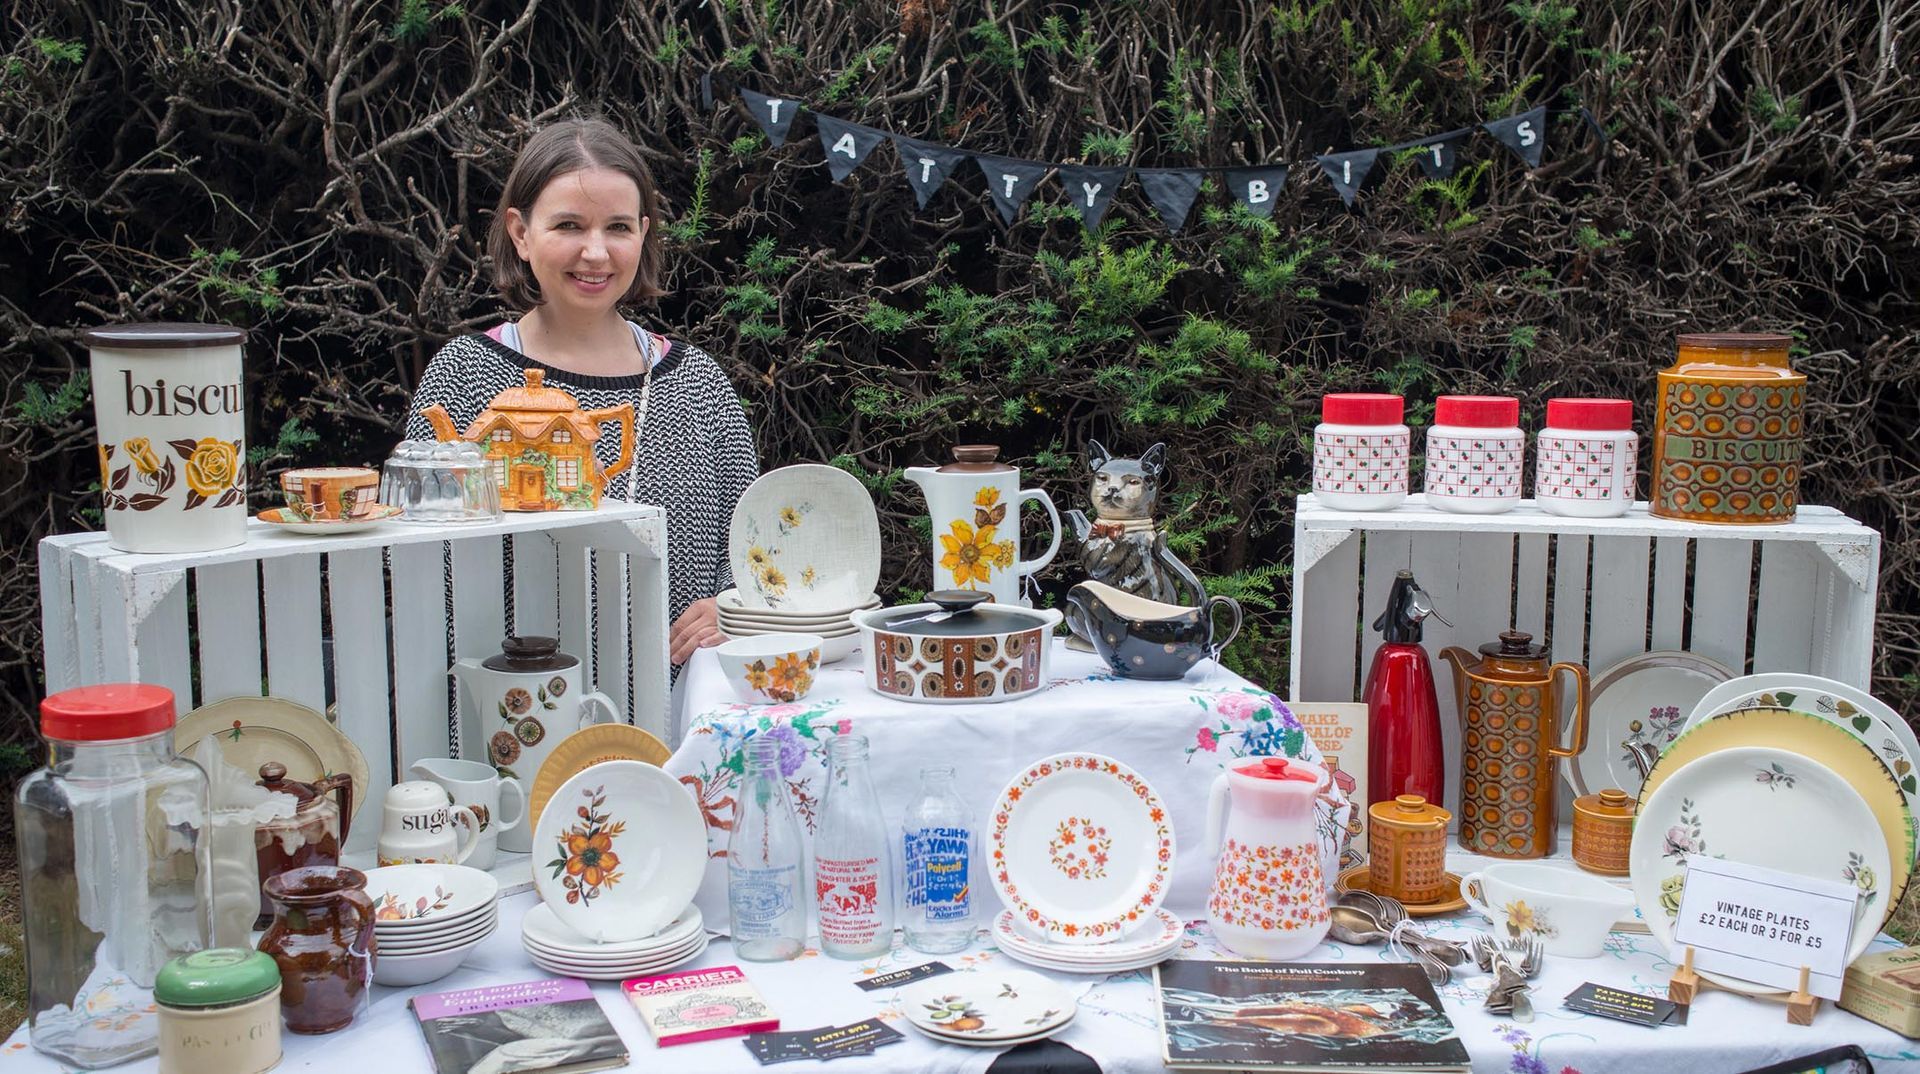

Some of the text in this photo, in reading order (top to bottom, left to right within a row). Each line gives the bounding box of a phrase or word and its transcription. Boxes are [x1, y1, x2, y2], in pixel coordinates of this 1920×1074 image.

[1304, 726, 1333, 738] EAL
[402, 808, 448, 834] suga
[1717, 901, 1810, 931] VINTAGE PLATES
[1699, 913, 1822, 949] £2 EACH OR 3 FOR £5
[633, 970, 739, 991] CARRIER
[1241, 966, 1273, 974] Book
[1287, 967, 1312, 975] Foil
[1313, 968, 1366, 977] Cookery
